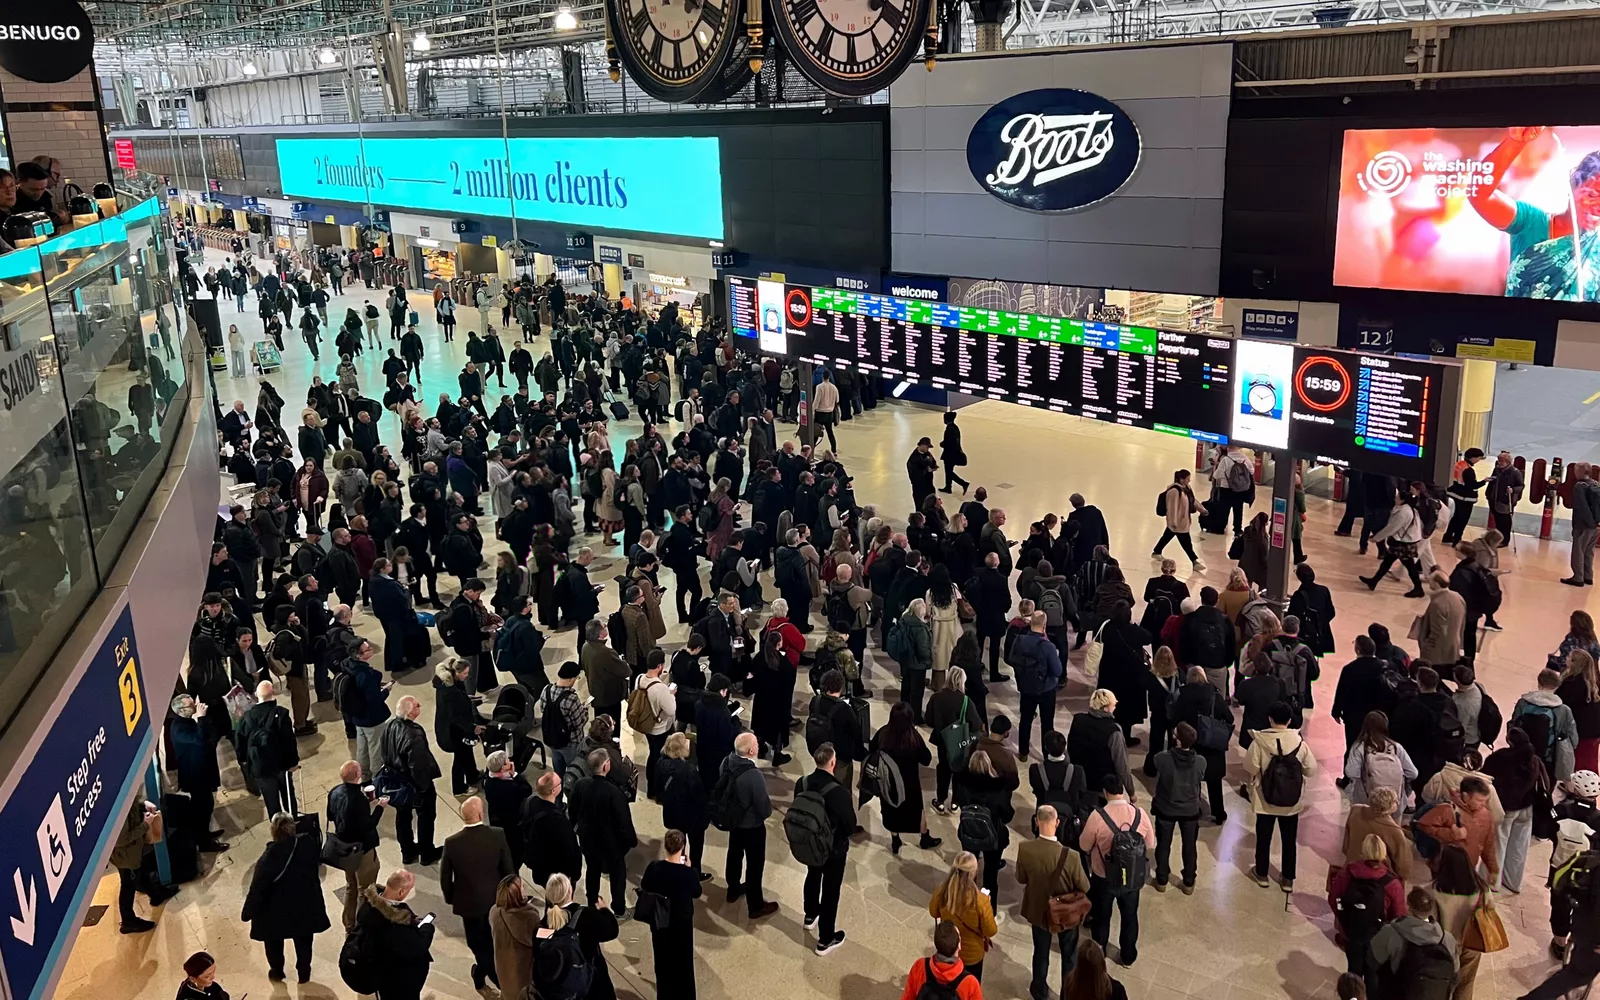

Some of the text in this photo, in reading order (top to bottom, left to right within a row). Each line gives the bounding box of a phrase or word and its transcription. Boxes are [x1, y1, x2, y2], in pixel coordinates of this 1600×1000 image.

[830, 13, 839, 22] 19
[0, 25, 81, 40] BENUGO
[673, 29, 681, 38] 18
[847, 23, 856, 32] 18
[986, 110, 1114, 187] Boots
[1423, 152, 1443, 161] the
[1422, 159, 1494, 174] washing
[313, 156, 628, 209] 2 founders 2 million clients
[460, 223, 466, 231] 9
[574, 237, 585, 246] 10
[713, 256, 721, 265] 11
[724, 255, 734, 265] 11
[892, 285, 938, 300] welcome
[790, 303, 806, 314] 15:59
[1158, 331, 1187, 343] Further
[1360, 331, 1381, 346] 12
[1386, 329, 1393, 345] 12
[1158, 342, 1200, 357] Departures
[1360, 356, 1389, 369] Status
[1305, 376, 1341, 393] 15:59
[1292, 411, 1314, 422] Special
[114, 635, 129, 667] Exit
[123, 669, 138, 723] 3
[66, 723, 106, 806] Step free
[74, 773, 103, 838] access
